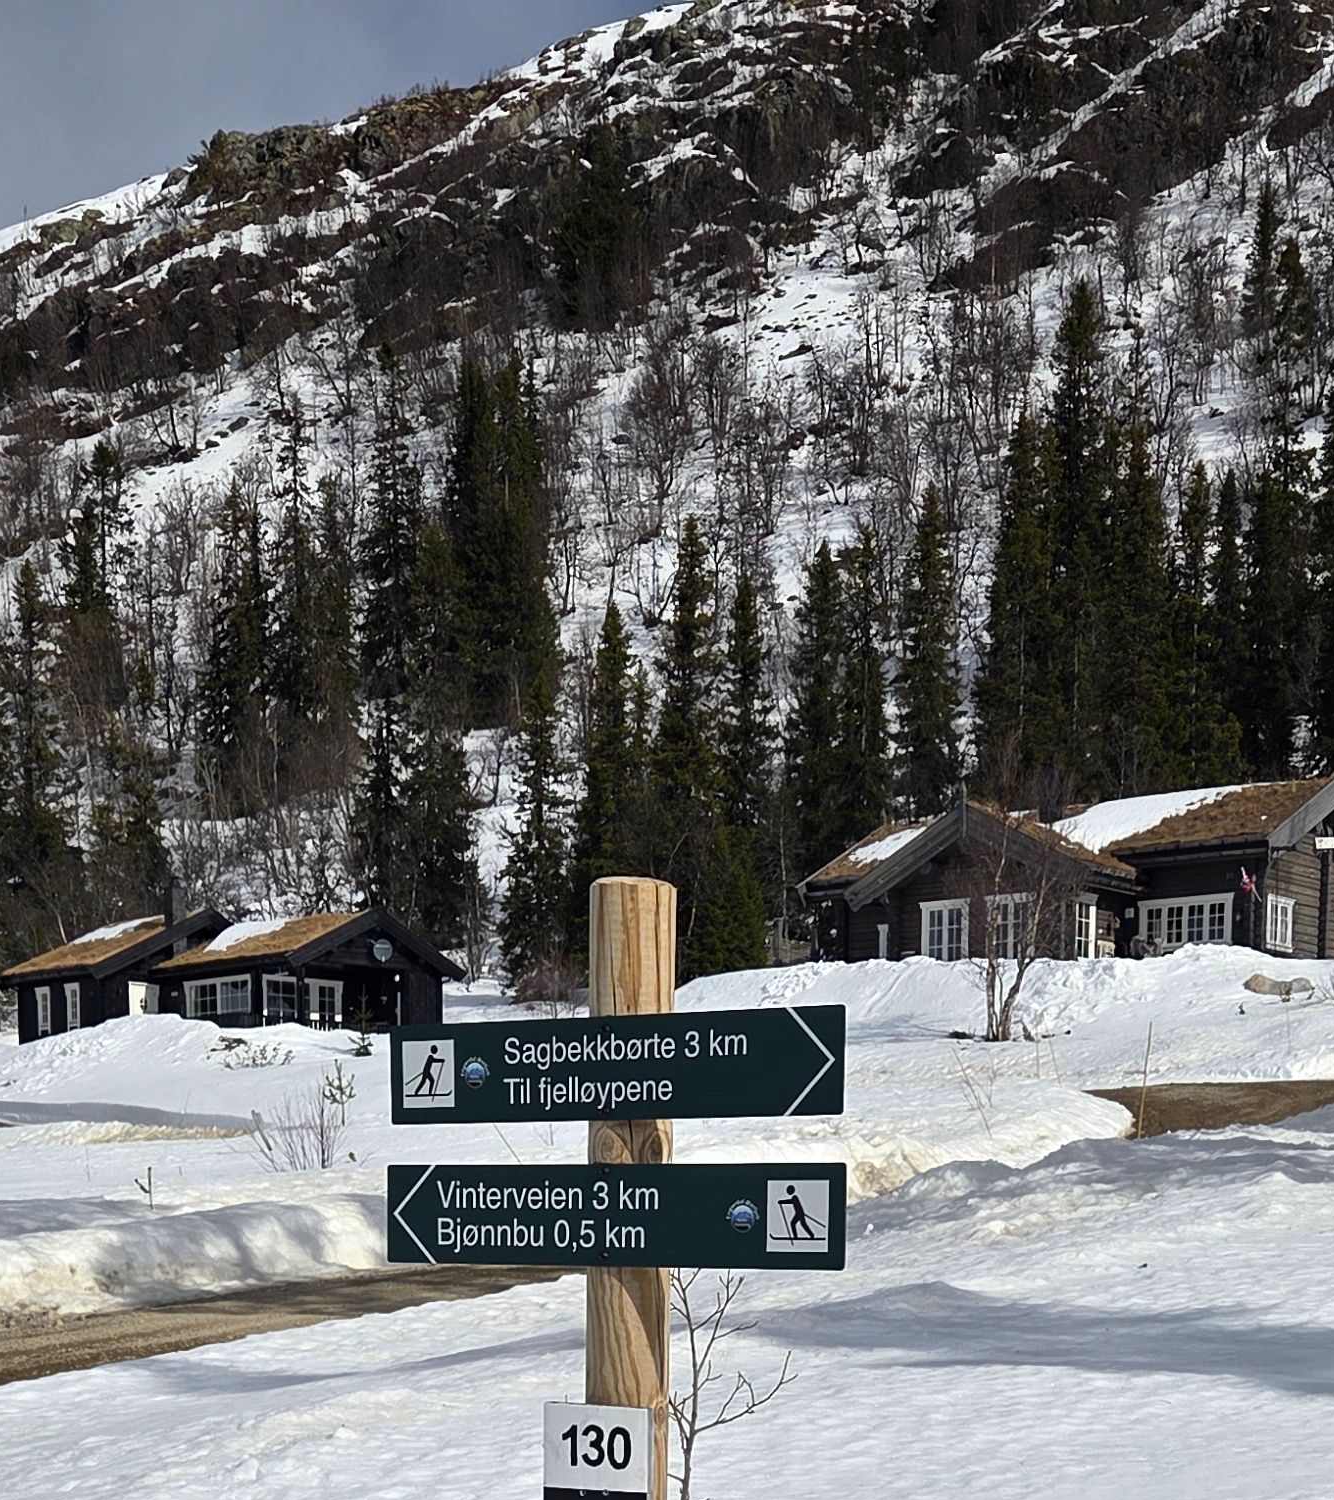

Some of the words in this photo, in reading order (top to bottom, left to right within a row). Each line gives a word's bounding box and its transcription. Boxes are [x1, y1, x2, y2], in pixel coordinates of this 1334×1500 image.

[503, 1034, 676, 1069] Sagbekkbørte
[684, 1032, 700, 1057] 3
[709, 1030, 748, 1056] km
[503, 1077, 531, 1105] Til
[538, 1076, 673, 1110] fjelløypene
[436, 1181, 583, 1210] Vinterveien
[592, 1183, 609, 1209] 3
[618, 1182, 660, 1210] km
[437, 1218, 544, 1254] Bjønnbu
[554, 1221, 596, 1253] 0,5
[605, 1221, 646, 1249] km
[561, 1424, 632, 1470] 130
